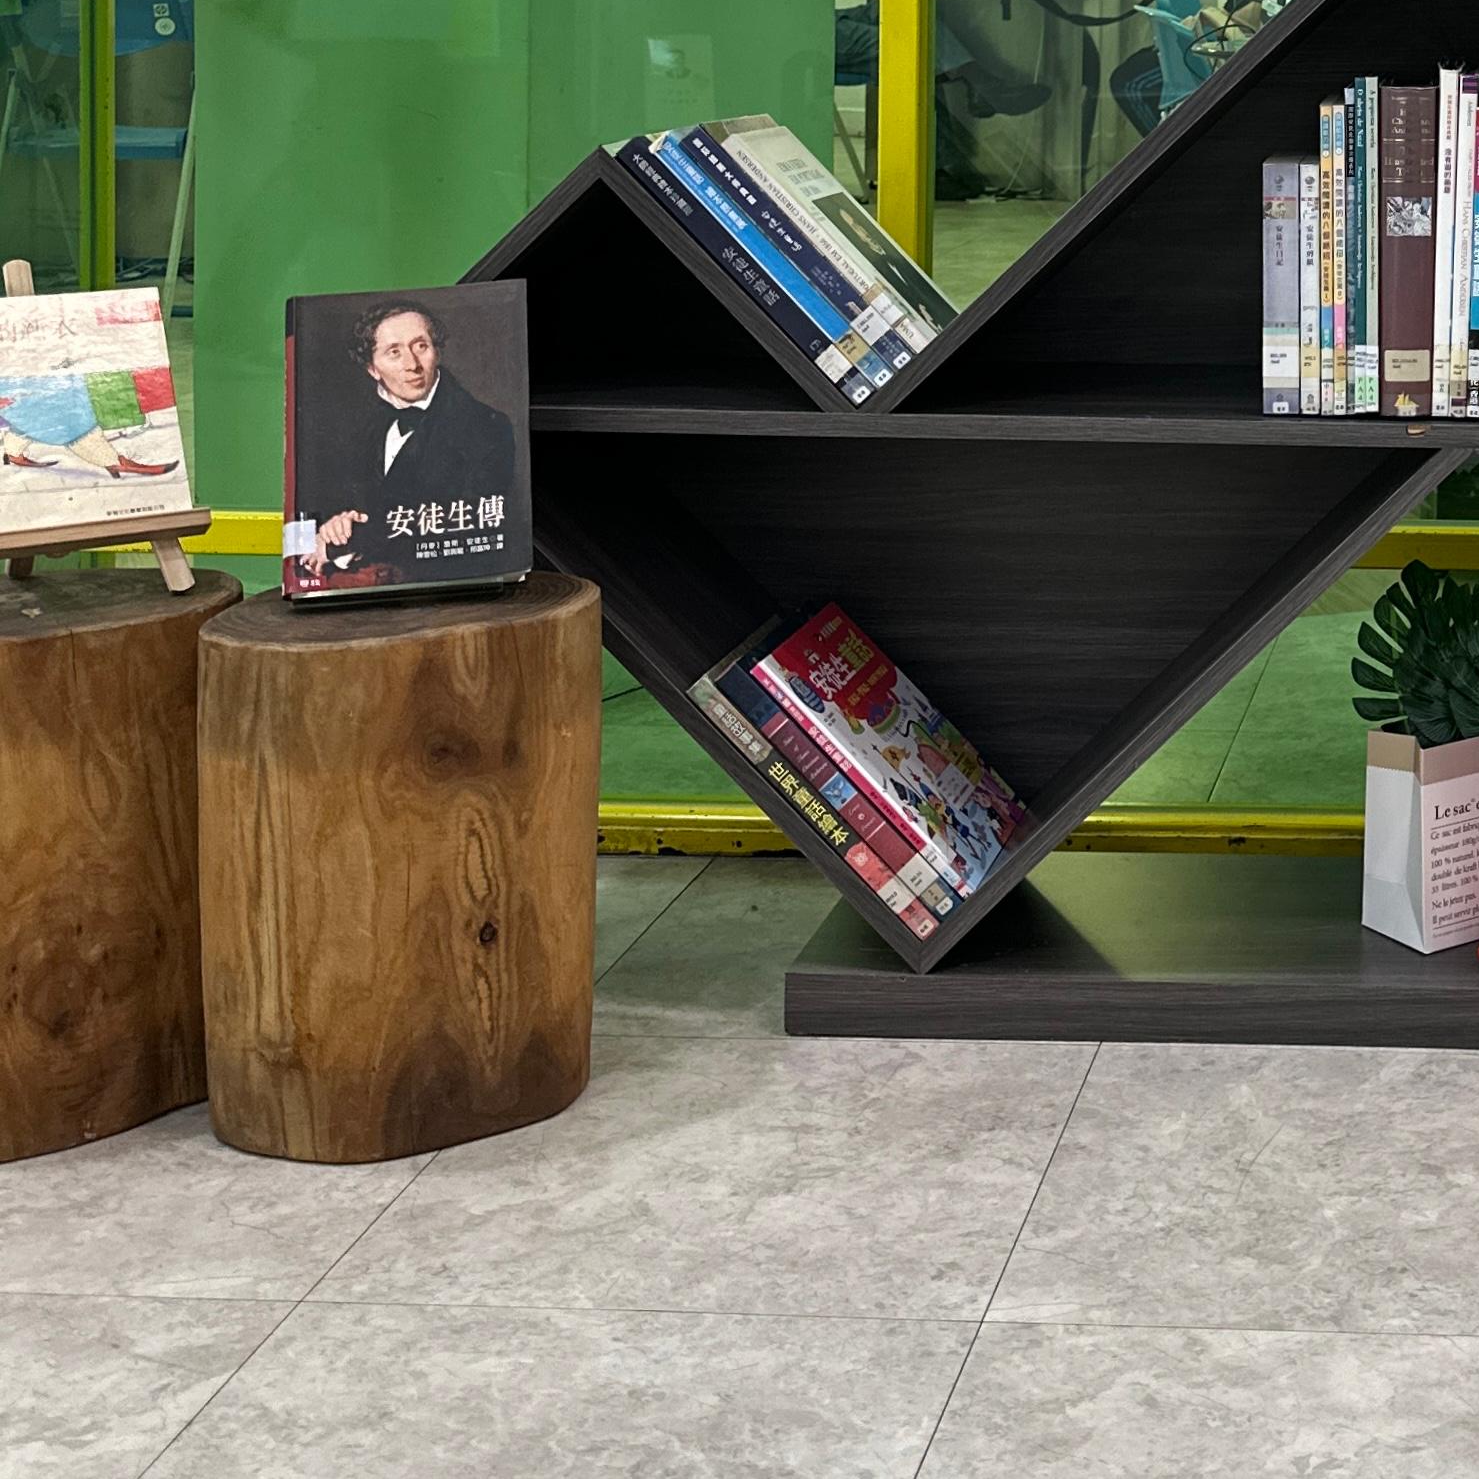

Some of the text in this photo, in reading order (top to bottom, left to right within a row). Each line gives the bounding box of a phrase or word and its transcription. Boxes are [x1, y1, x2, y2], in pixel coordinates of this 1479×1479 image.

[734, 149, 769, 184] ANDERSEN
[765, 182, 801, 218] CHRISTIAN
[797, 214, 817, 234] HANS
[386, 495, 505, 539] 安徒生傳
[809, 630, 875, 701] 安徒生童話
[709, 703, 762, 757] 童話故事集
[767, 761, 851, 847] 世界童話繪本
[1434, 805, 1451, 820] Le
[1431, 831, 1440, 840] Ce
[1432, 859, 1443, 869] 100
[1432, 901, 1442, 910] Ne
